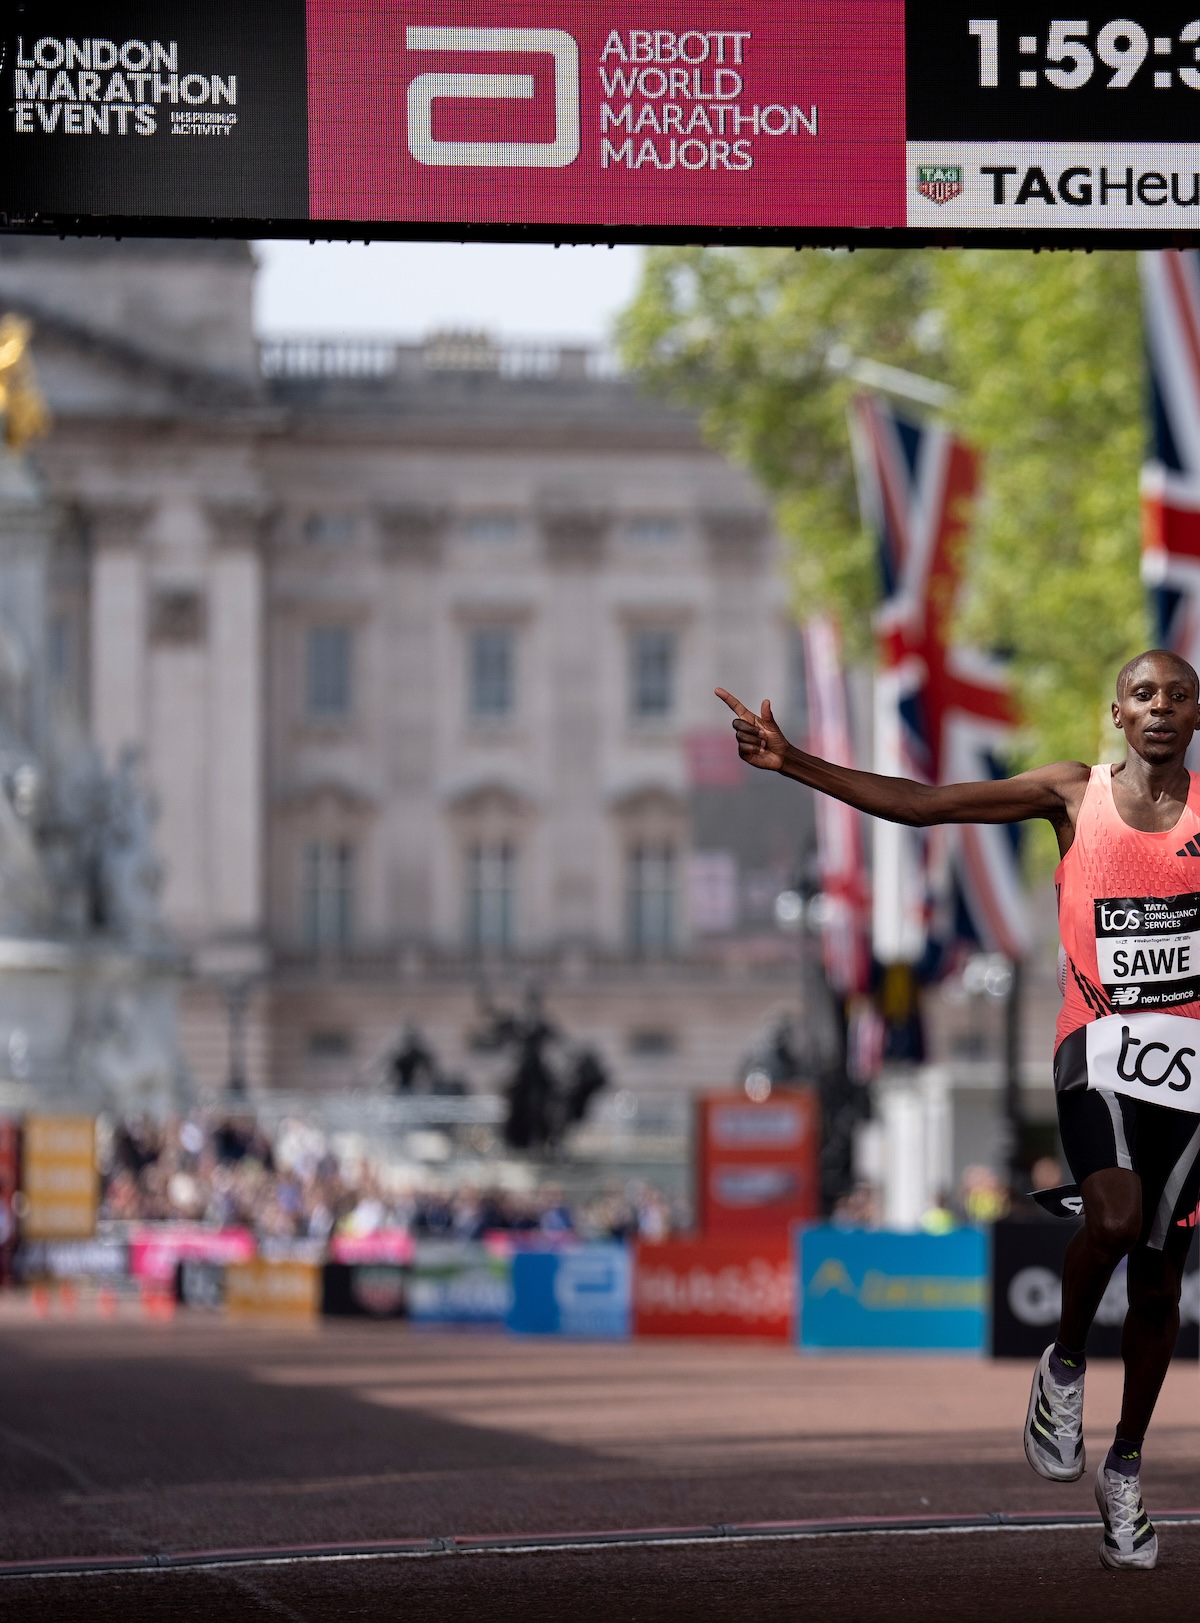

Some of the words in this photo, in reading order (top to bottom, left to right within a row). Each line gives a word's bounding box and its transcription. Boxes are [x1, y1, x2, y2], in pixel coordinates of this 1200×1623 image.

[17, 36, 178, 72] LONDON
[600, 30, 751, 64] ABBOTT
[15, 69, 237, 105] MARATHON
[600, 67, 742, 99] WORLD
[15, 101, 157, 136] EVENTS
[171, 112, 237, 124] INSPIRING
[171, 124, 232, 135] ACTIVITY
[600, 103, 818, 136] MARATHON
[600, 139, 753, 170] MAJORS
[922, 169, 958, 181] TAG
[1101, 905, 1140, 931] tcs
[1144, 903, 1168, 911] TATA
[1144, 908, 1197, 920] CONSULTANCY
[1144, 920, 1181, 929] SERVICES
[1113, 946, 1190, 978] SAWE
[1141, 996, 1160, 1004] new
[1162, 990, 1194, 1002] balance
[1117, 1025, 1196, 1092] tcs
